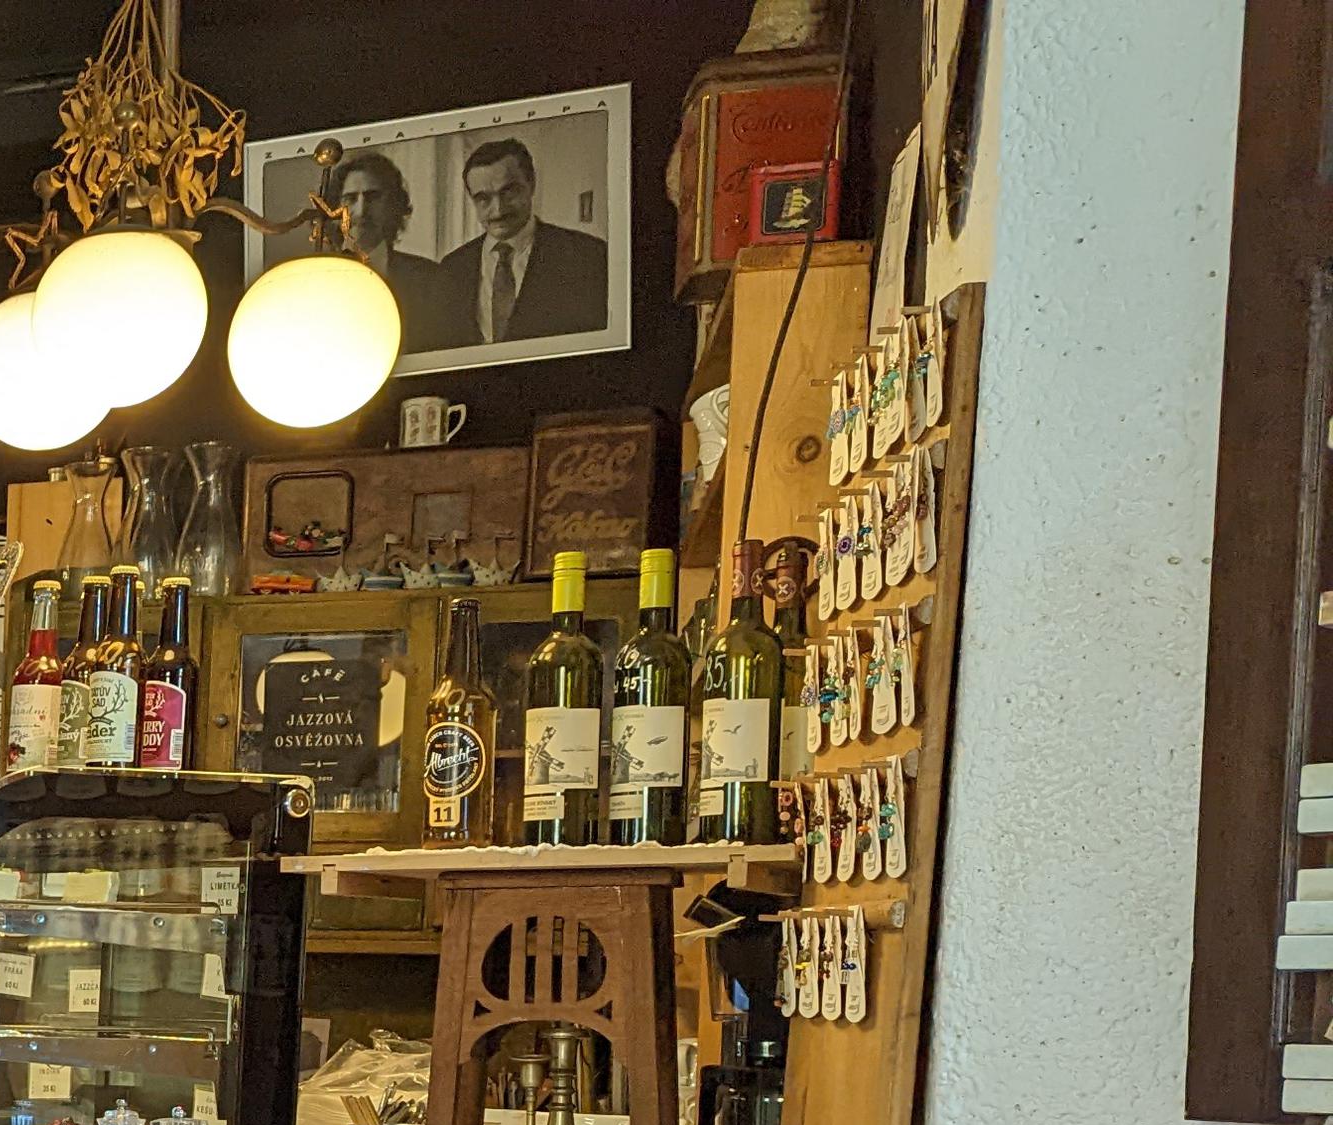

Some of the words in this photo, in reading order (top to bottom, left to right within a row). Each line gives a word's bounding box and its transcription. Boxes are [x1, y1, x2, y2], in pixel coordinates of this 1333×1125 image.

[265, 131, 405, 159] ZAPA
[459, 100, 607, 128] ZUPPA
[286, 710, 354, 726] JAZZOVÁ
[275, 732, 364, 748] OSVĚŽOVNA
[423, 746, 480, 778] Albrecht
[434, 806, 454, 823] 11
